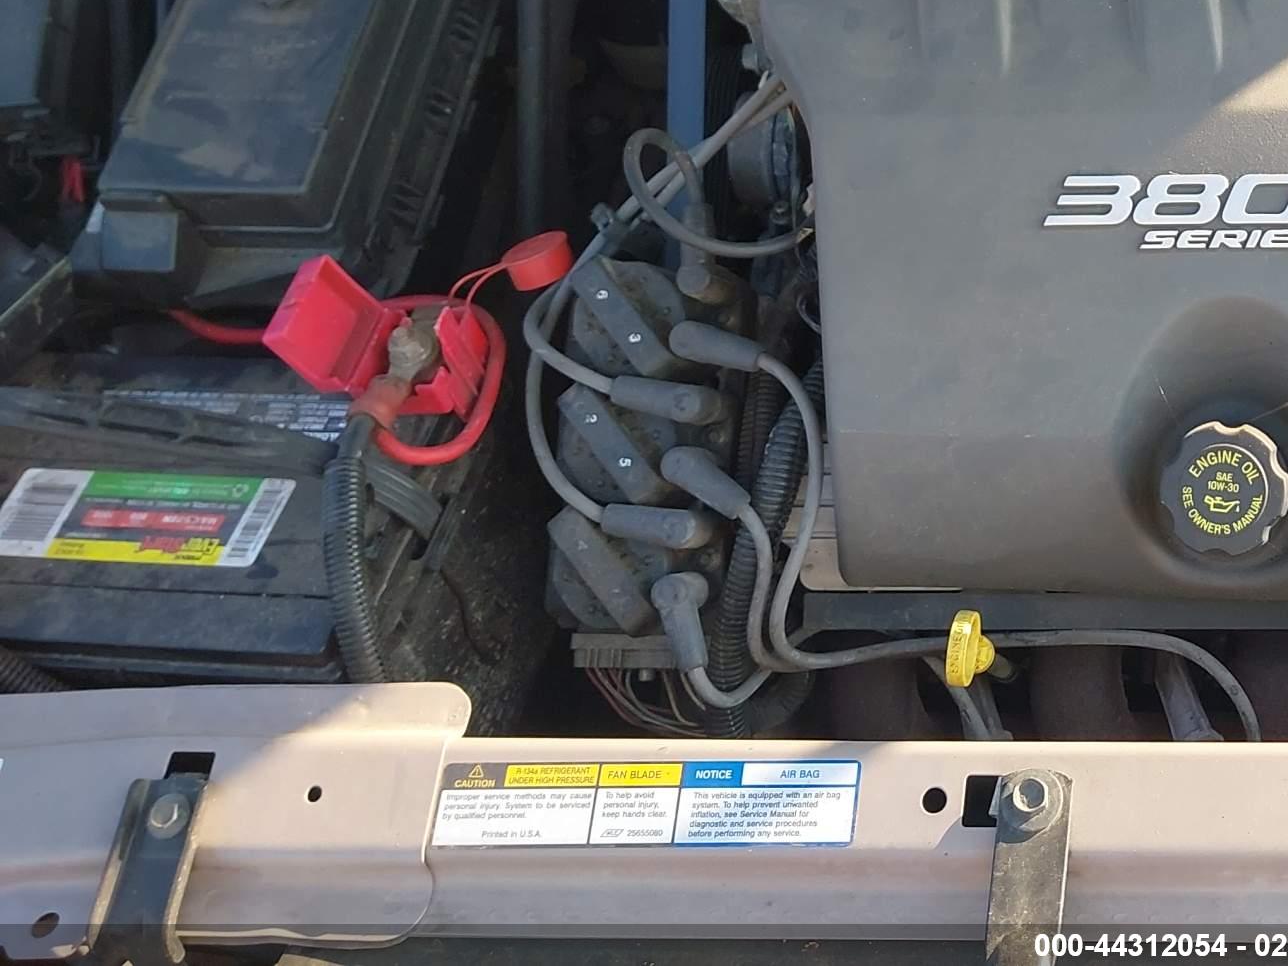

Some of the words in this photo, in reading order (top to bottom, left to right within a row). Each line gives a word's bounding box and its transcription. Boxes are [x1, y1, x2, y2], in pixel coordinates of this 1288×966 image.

[1188, 450, 1242, 478] ENGINE
[1241, 461, 1260, 485] OIL
[1216, 472, 1233, 482] SAE
[1208, 481, 1240, 493] 10W-30
[1182, 486, 1194, 508] SEE
[1188, 508, 1231, 535] OWNER'S
[1232, 494, 1264, 532] MANUAL
[540, 766, 590, 774] REFRIGERANT
[608, 770, 627, 778] FAN
[630, 770, 662, 778] BLADE
[695, 770, 733, 780] NOTICE
[780, 770, 796, 778] AIR
[800, 770, 820, 779] BAG
[454, 779, 496, 788] CAUTION
[508, 776, 534, 784] UNDER
[536, 776, 554, 784] HIGH
[556, 776, 595, 784] PRESSURE
[446, 794, 480, 802] Improper
[616, 792, 632, 800] help
[748, 792, 784, 800] equipped
[826, 792, 841, 800] bag
[444, 802, 477, 812] personal
[505, 802, 533, 810] System
[560, 801, 590, 809] serviced
[603, 802, 636, 810] personal
[692, 802, 720, 810] system.
[734, 801, 750, 810] help
[752, 802, 781, 810] prevent
[782, 800, 818, 808] unwanted
[454, 812, 486, 820] qualified
[740, 810, 768, 818] Service
[770, 810, 797, 818] Manual
[799, 810, 810, 818] for
[690, 820, 728, 828] diagnostic
[730, 820, 744, 828] and
[746, 820, 773, 828] service
[775, 820, 818, 828] procedures
[482, 830, 508, 838] Printed
[511, 830, 518, 838] in
[688, 830, 712, 838] before
[714, 830, 755, 839] performing
